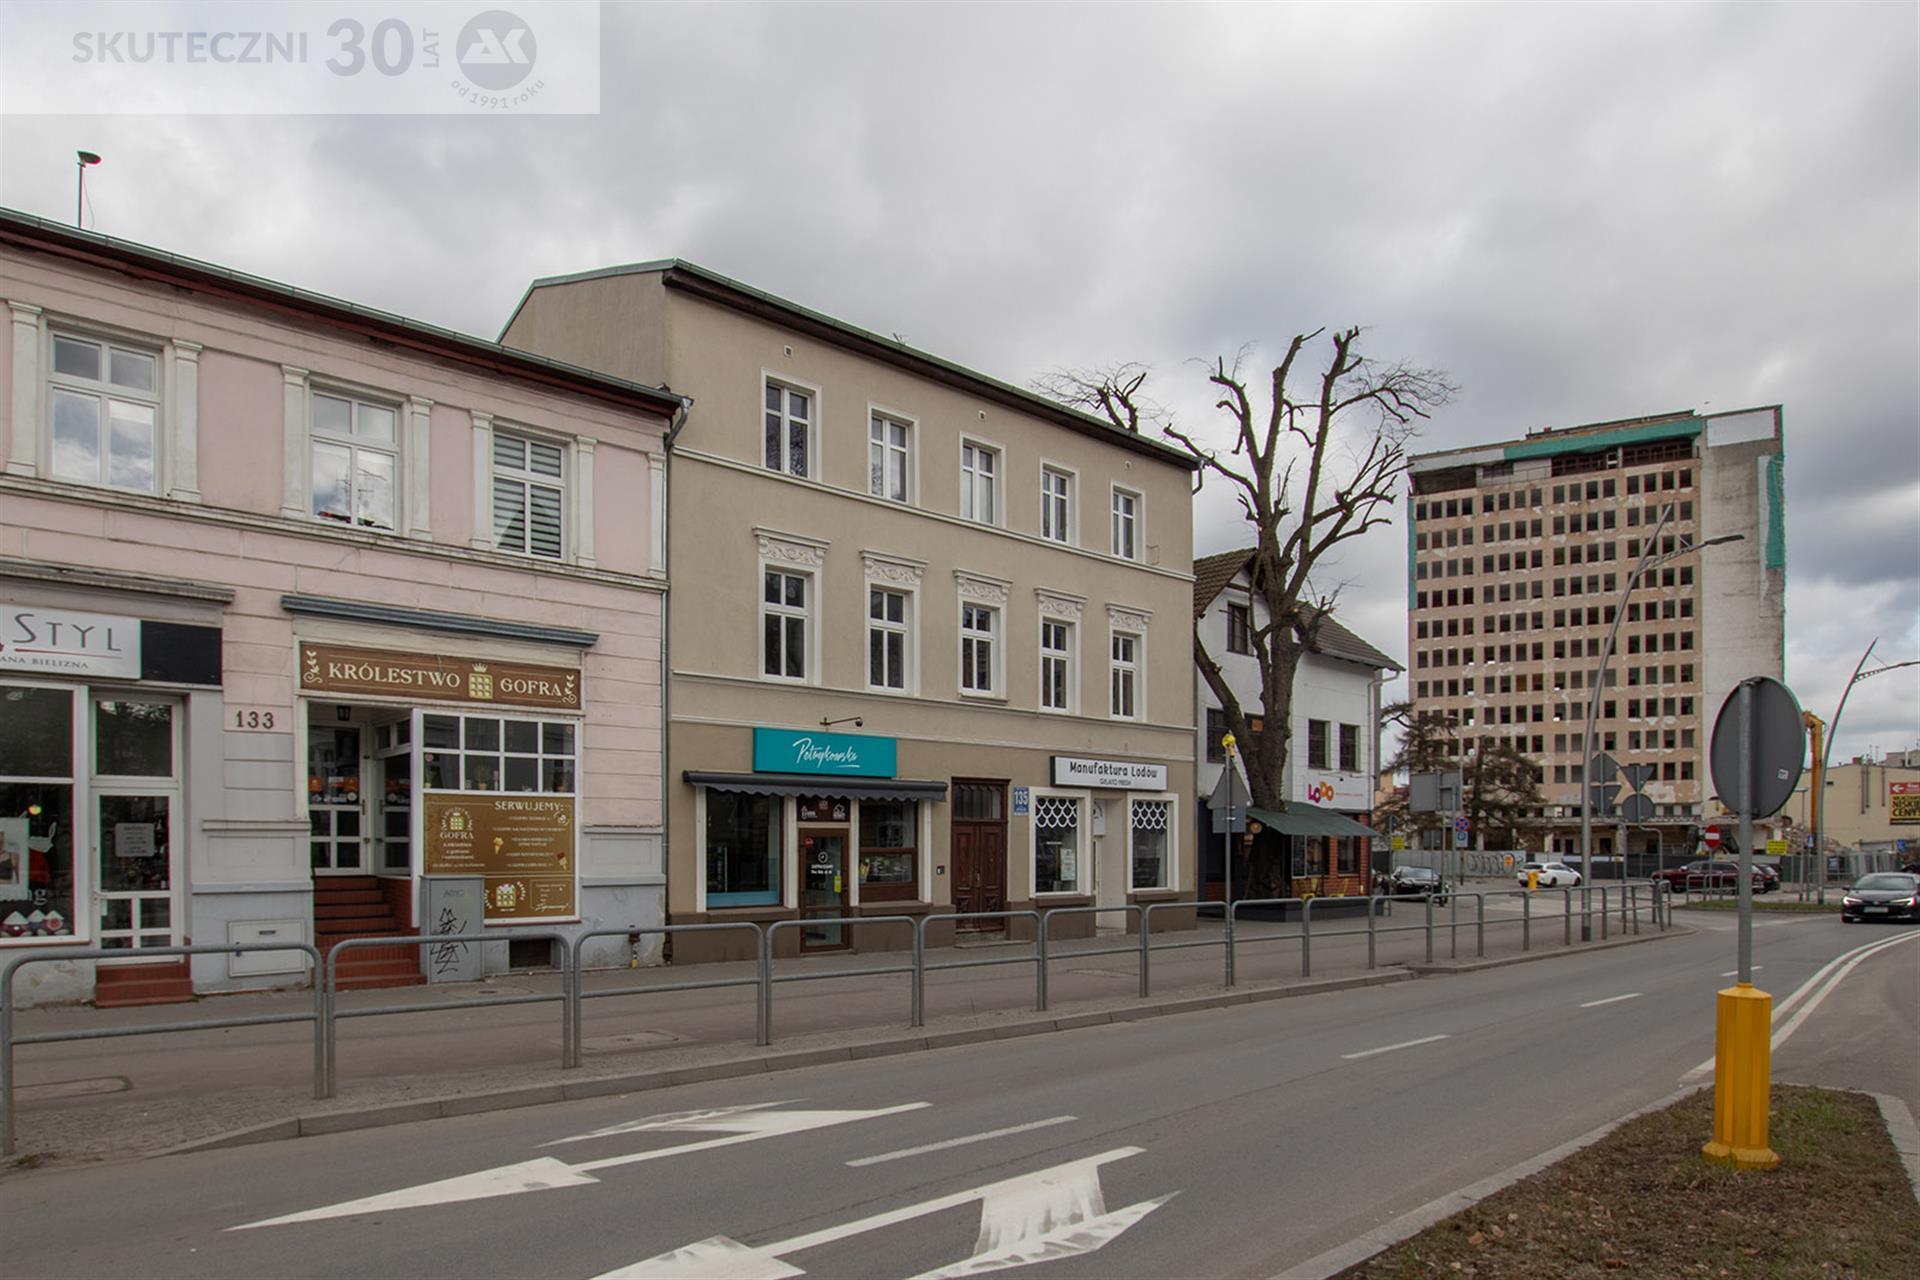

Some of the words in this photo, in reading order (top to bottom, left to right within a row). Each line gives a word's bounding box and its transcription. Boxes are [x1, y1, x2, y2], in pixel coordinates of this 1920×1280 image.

[32, 658, 89, 669] BIELIZNA
[328, 662, 461, 688] KRÓLESTWO
[500, 678, 562, 697] GOFRA
[236, 709, 274, 729] 133
[1069, 761, 1128, 776] Manufaktura
[1131, 766, 1158, 778] Lodów
[1014, 790, 1028, 805] 135
